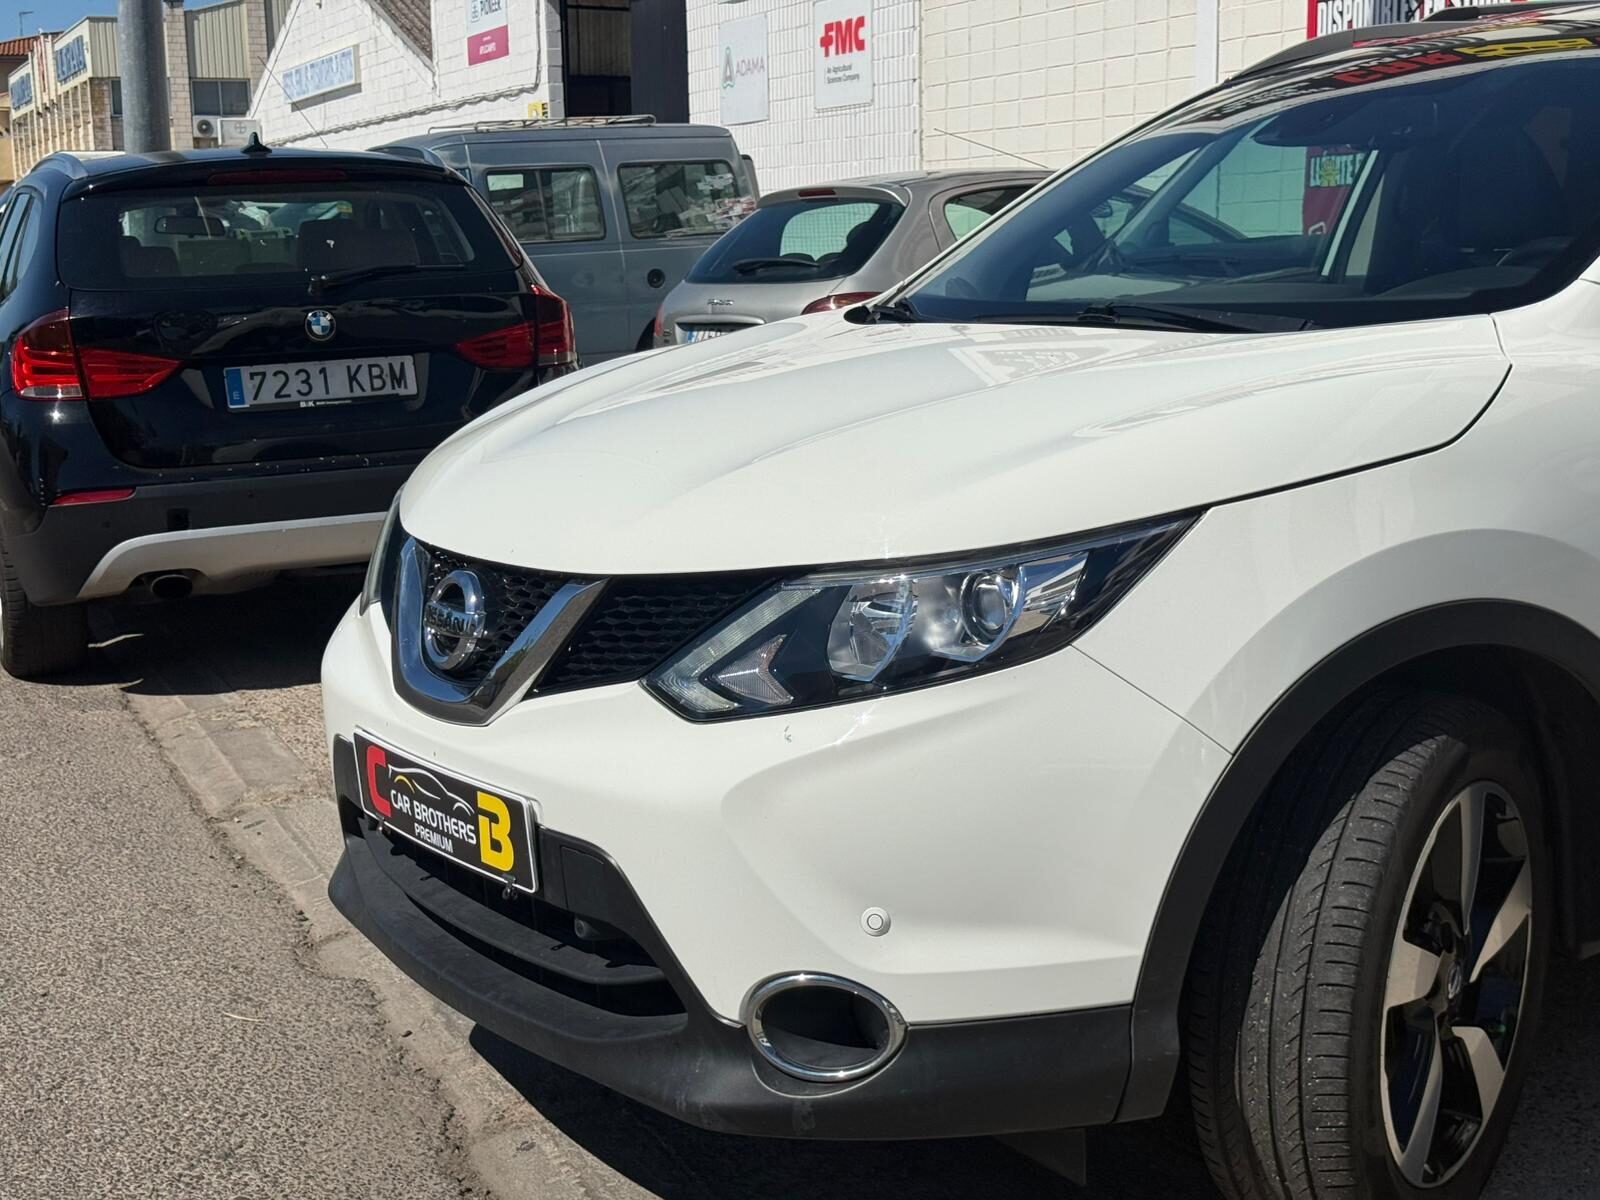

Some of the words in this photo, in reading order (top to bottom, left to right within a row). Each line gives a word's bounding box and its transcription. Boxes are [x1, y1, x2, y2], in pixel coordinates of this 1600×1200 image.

[820, 16, 865, 57] FMC
[736, 57, 765, 77] ADAMA
[249, 367, 330, 401] 7231
[347, 361, 408, 394] KBM
[390, 789, 411, 817] CAR
[413, 800, 477, 845] BROTHERS
[477, 791, 514, 871] B
[414, 822, 454, 853] PREMIUM
